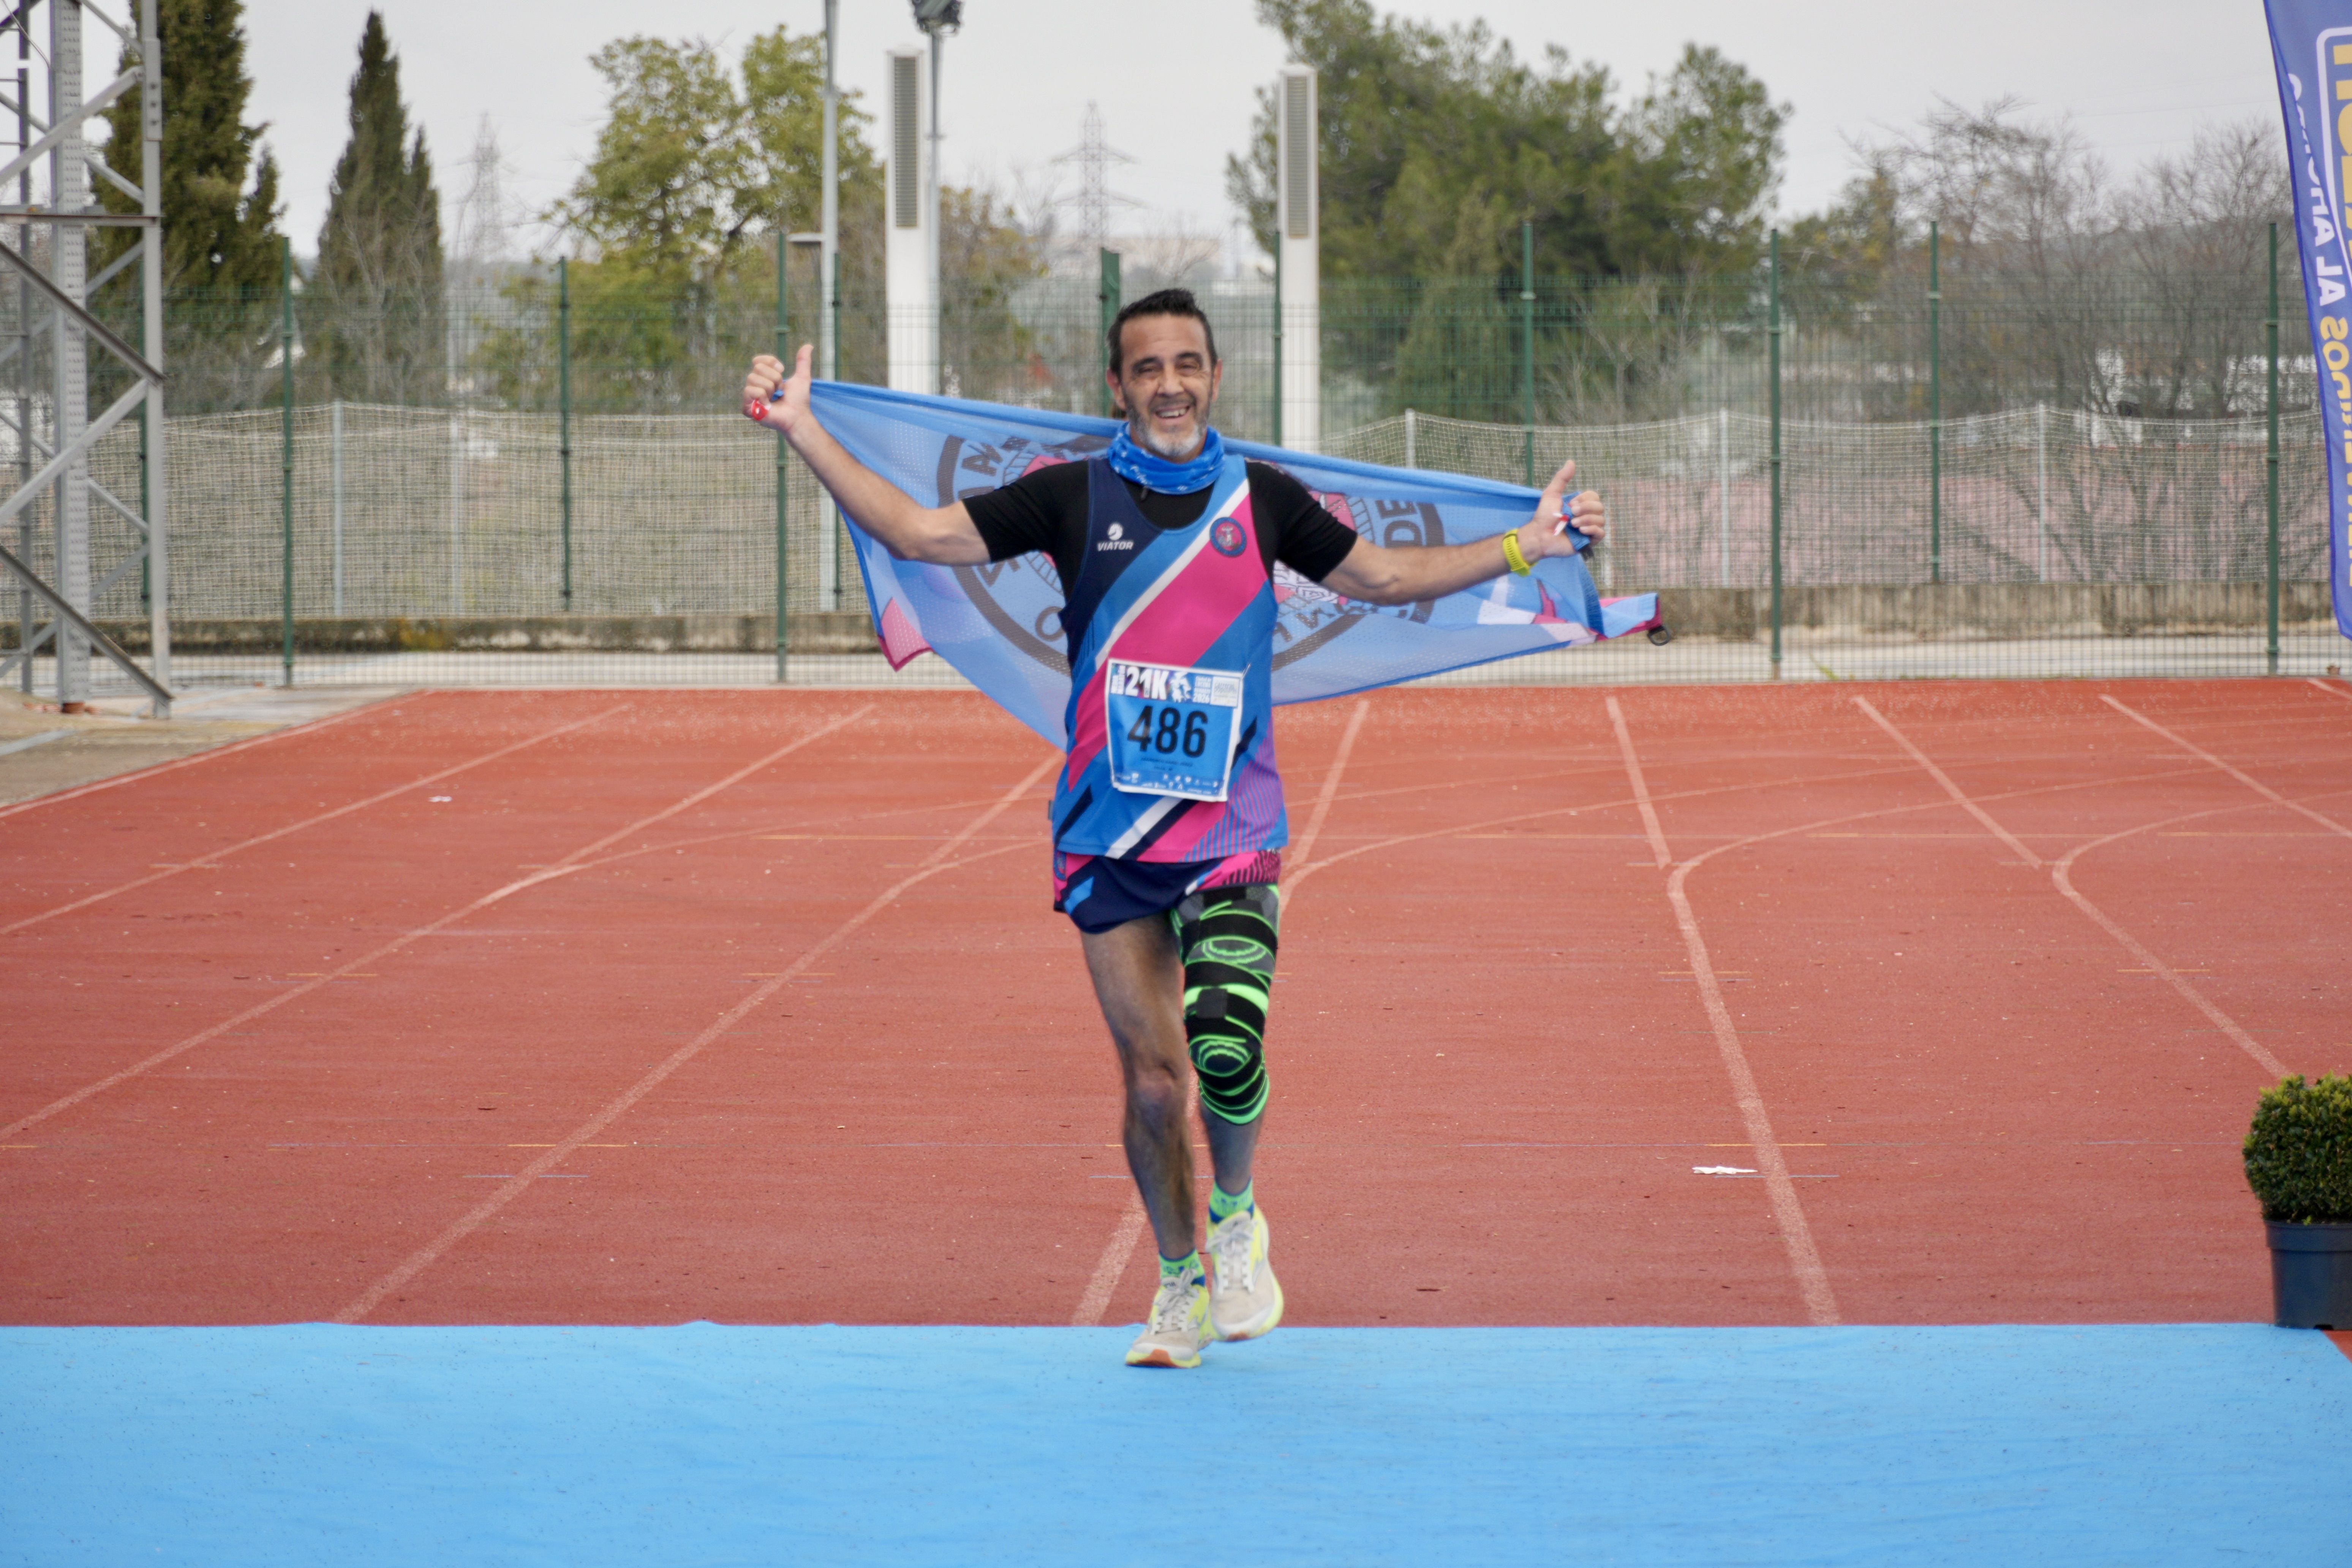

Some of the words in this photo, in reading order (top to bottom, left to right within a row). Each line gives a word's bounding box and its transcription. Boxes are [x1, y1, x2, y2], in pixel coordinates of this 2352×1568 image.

[1097, 541, 1134, 552] VIATOR
[1125, 666, 1170, 700] 21K
[1127, 705, 1209, 758] 486
